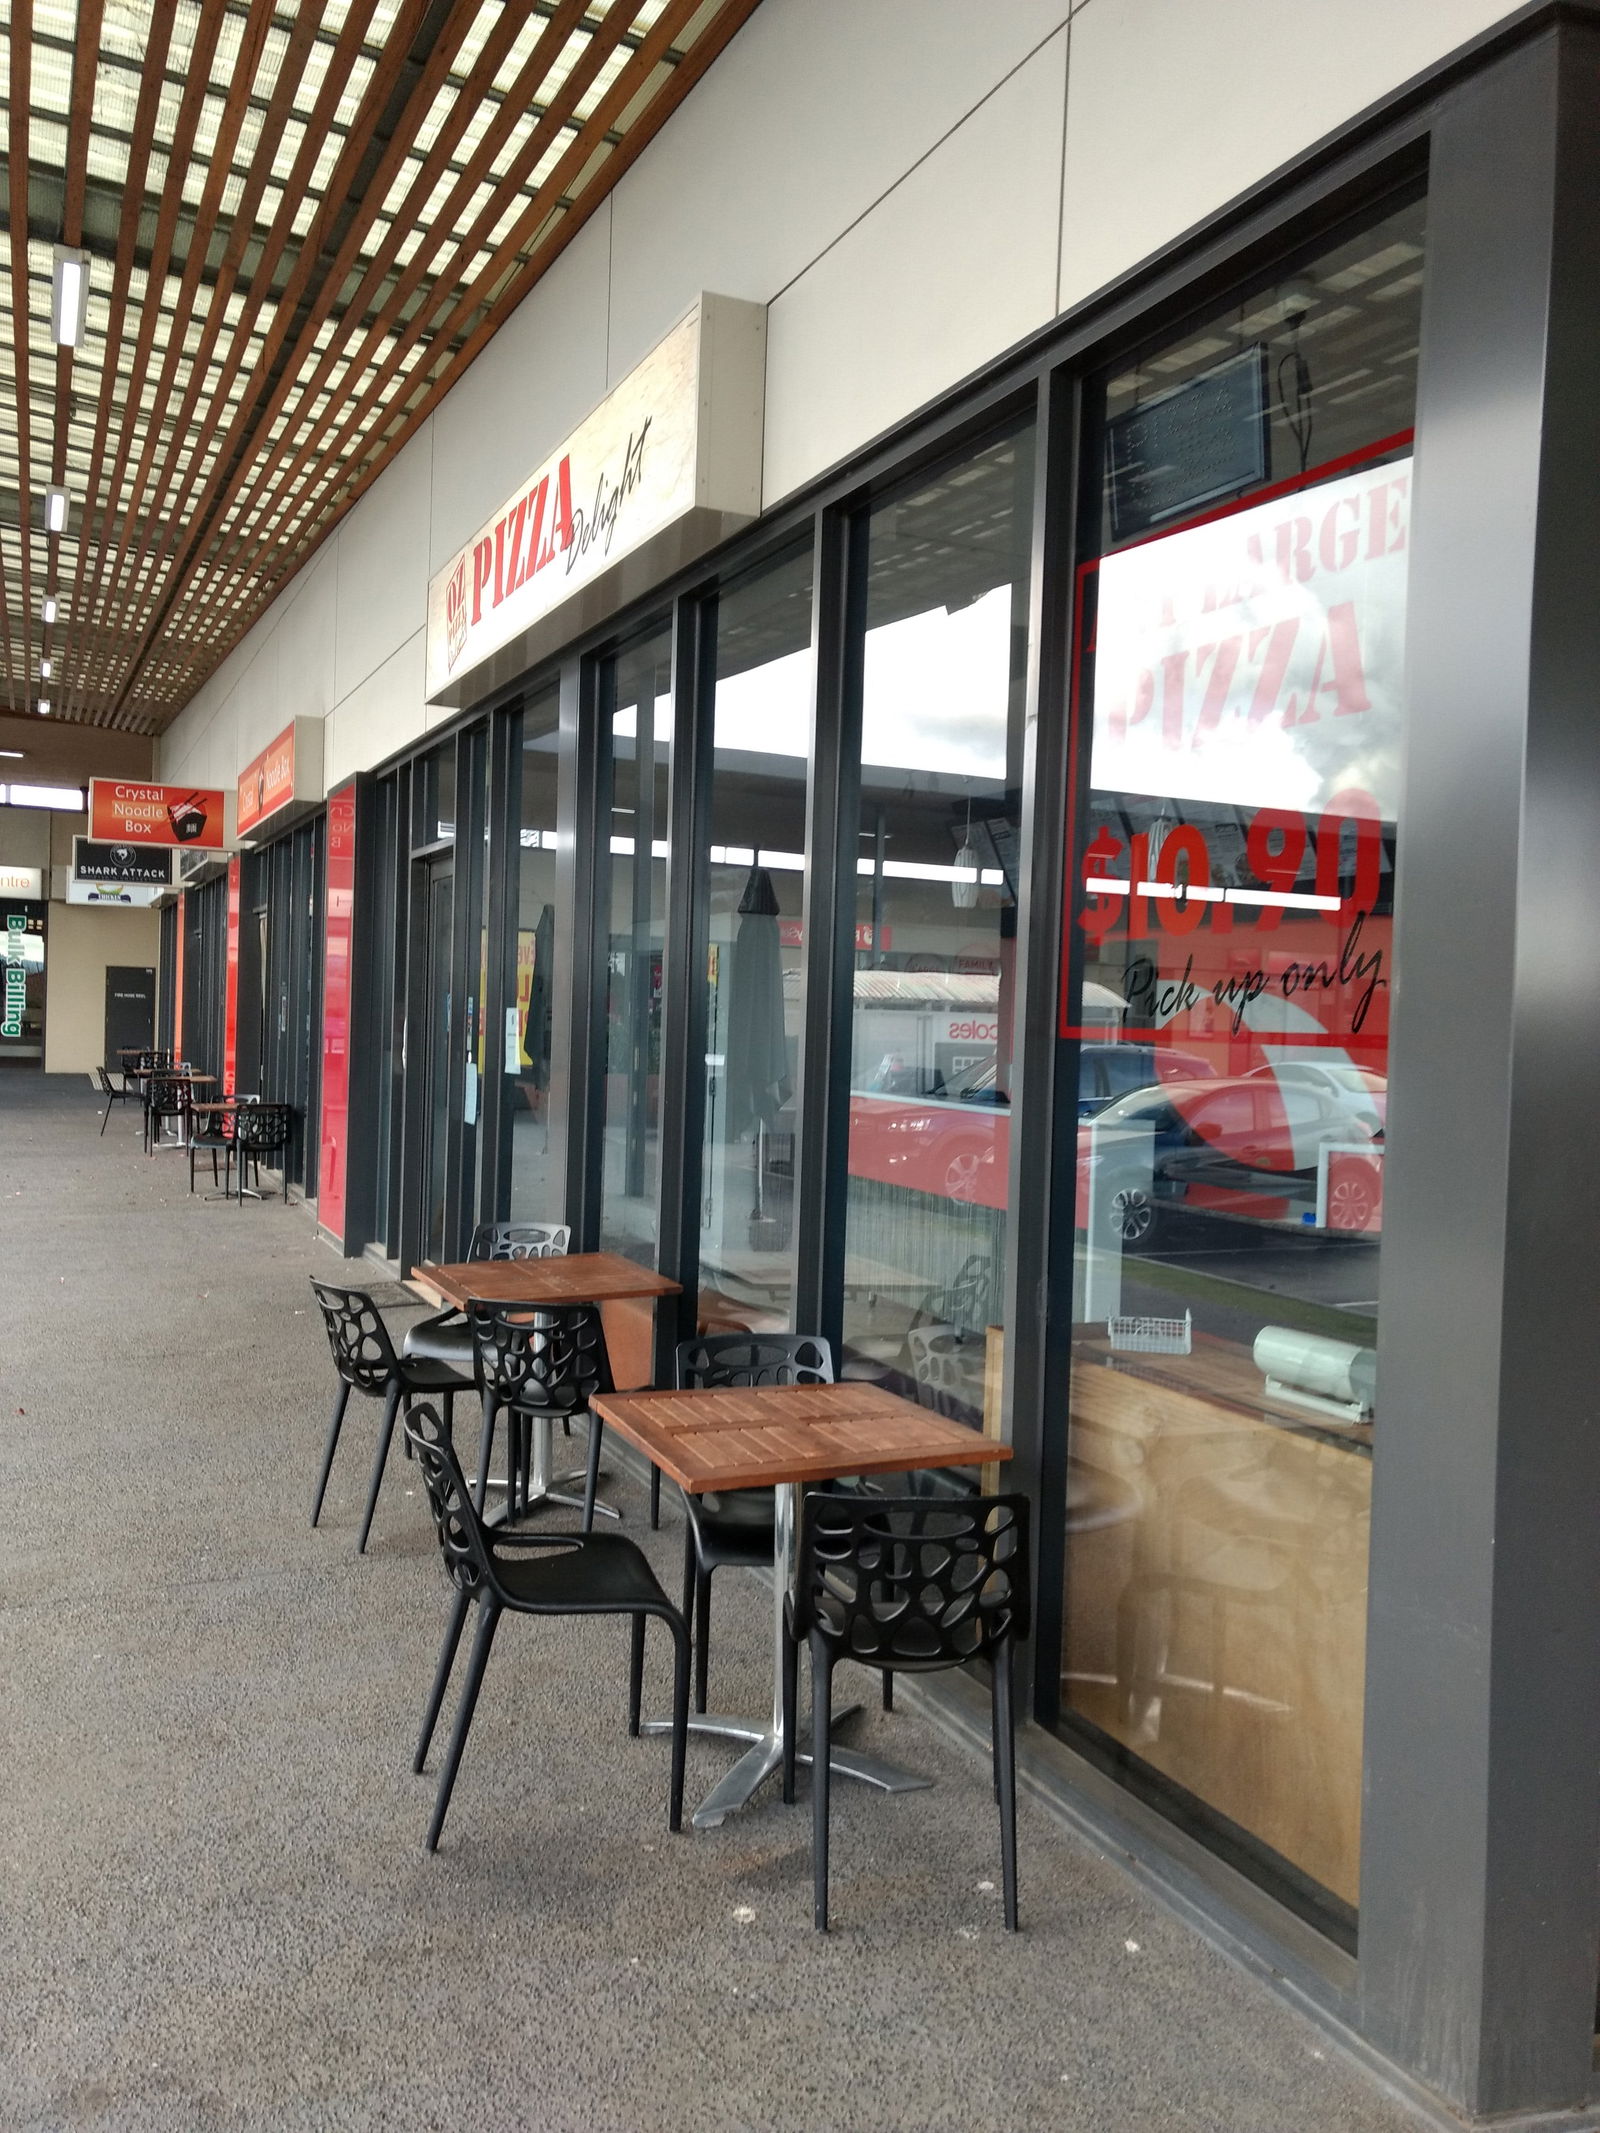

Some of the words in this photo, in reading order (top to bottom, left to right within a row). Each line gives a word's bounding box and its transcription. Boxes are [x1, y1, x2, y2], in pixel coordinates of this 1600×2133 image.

[564, 415, 652, 576] Delight
[471, 453, 574, 627] PIZZA
[1107, 600, 1373, 750] PIZZA
[113, 803, 163, 817] Noodle
[115, 785, 164, 800] Crystal
[125, 821, 152, 833] Box
[80, 865, 118, 876] SHARK
[122, 869, 165, 878] ATTACK
[1077, 787, 1382, 946] $10.90
[7, 914, 27, 966] Bulk
[1122, 953, 1201, 1023] Pick
[1213, 966, 1270, 1037] up
[1280, 910, 1387, 1034] only
[1, 968, 26, 1038] Billing
